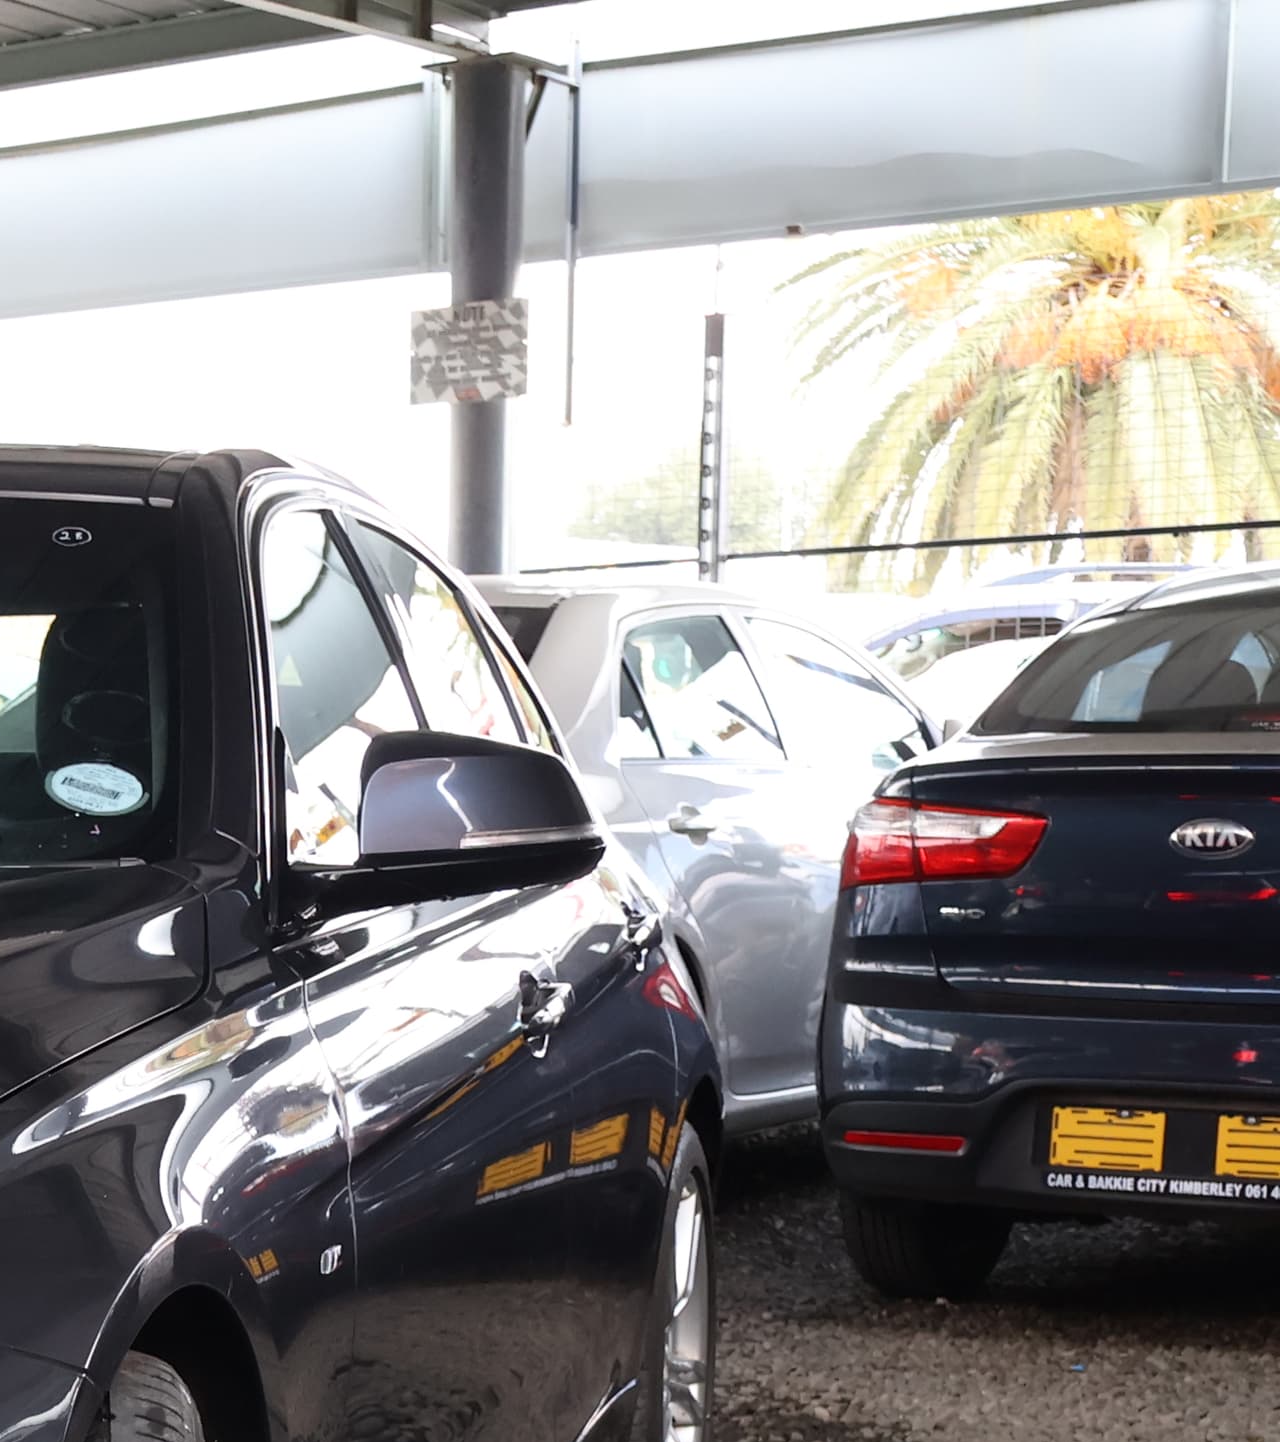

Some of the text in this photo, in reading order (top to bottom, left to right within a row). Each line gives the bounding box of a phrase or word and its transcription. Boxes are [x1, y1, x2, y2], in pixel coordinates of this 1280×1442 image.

[1183, 824, 1238, 847] KIA
[1047, 1173, 1073, 1188] CAR
[1075, 1174, 1085, 1188] &
[1088, 1175, 1135, 1191] BAKKIE
[1137, 1178, 1167, 1193] CITY
[1169, 1180, 1242, 1197] KIMBERLEY
[1245, 1184, 1268, 1199] 061
